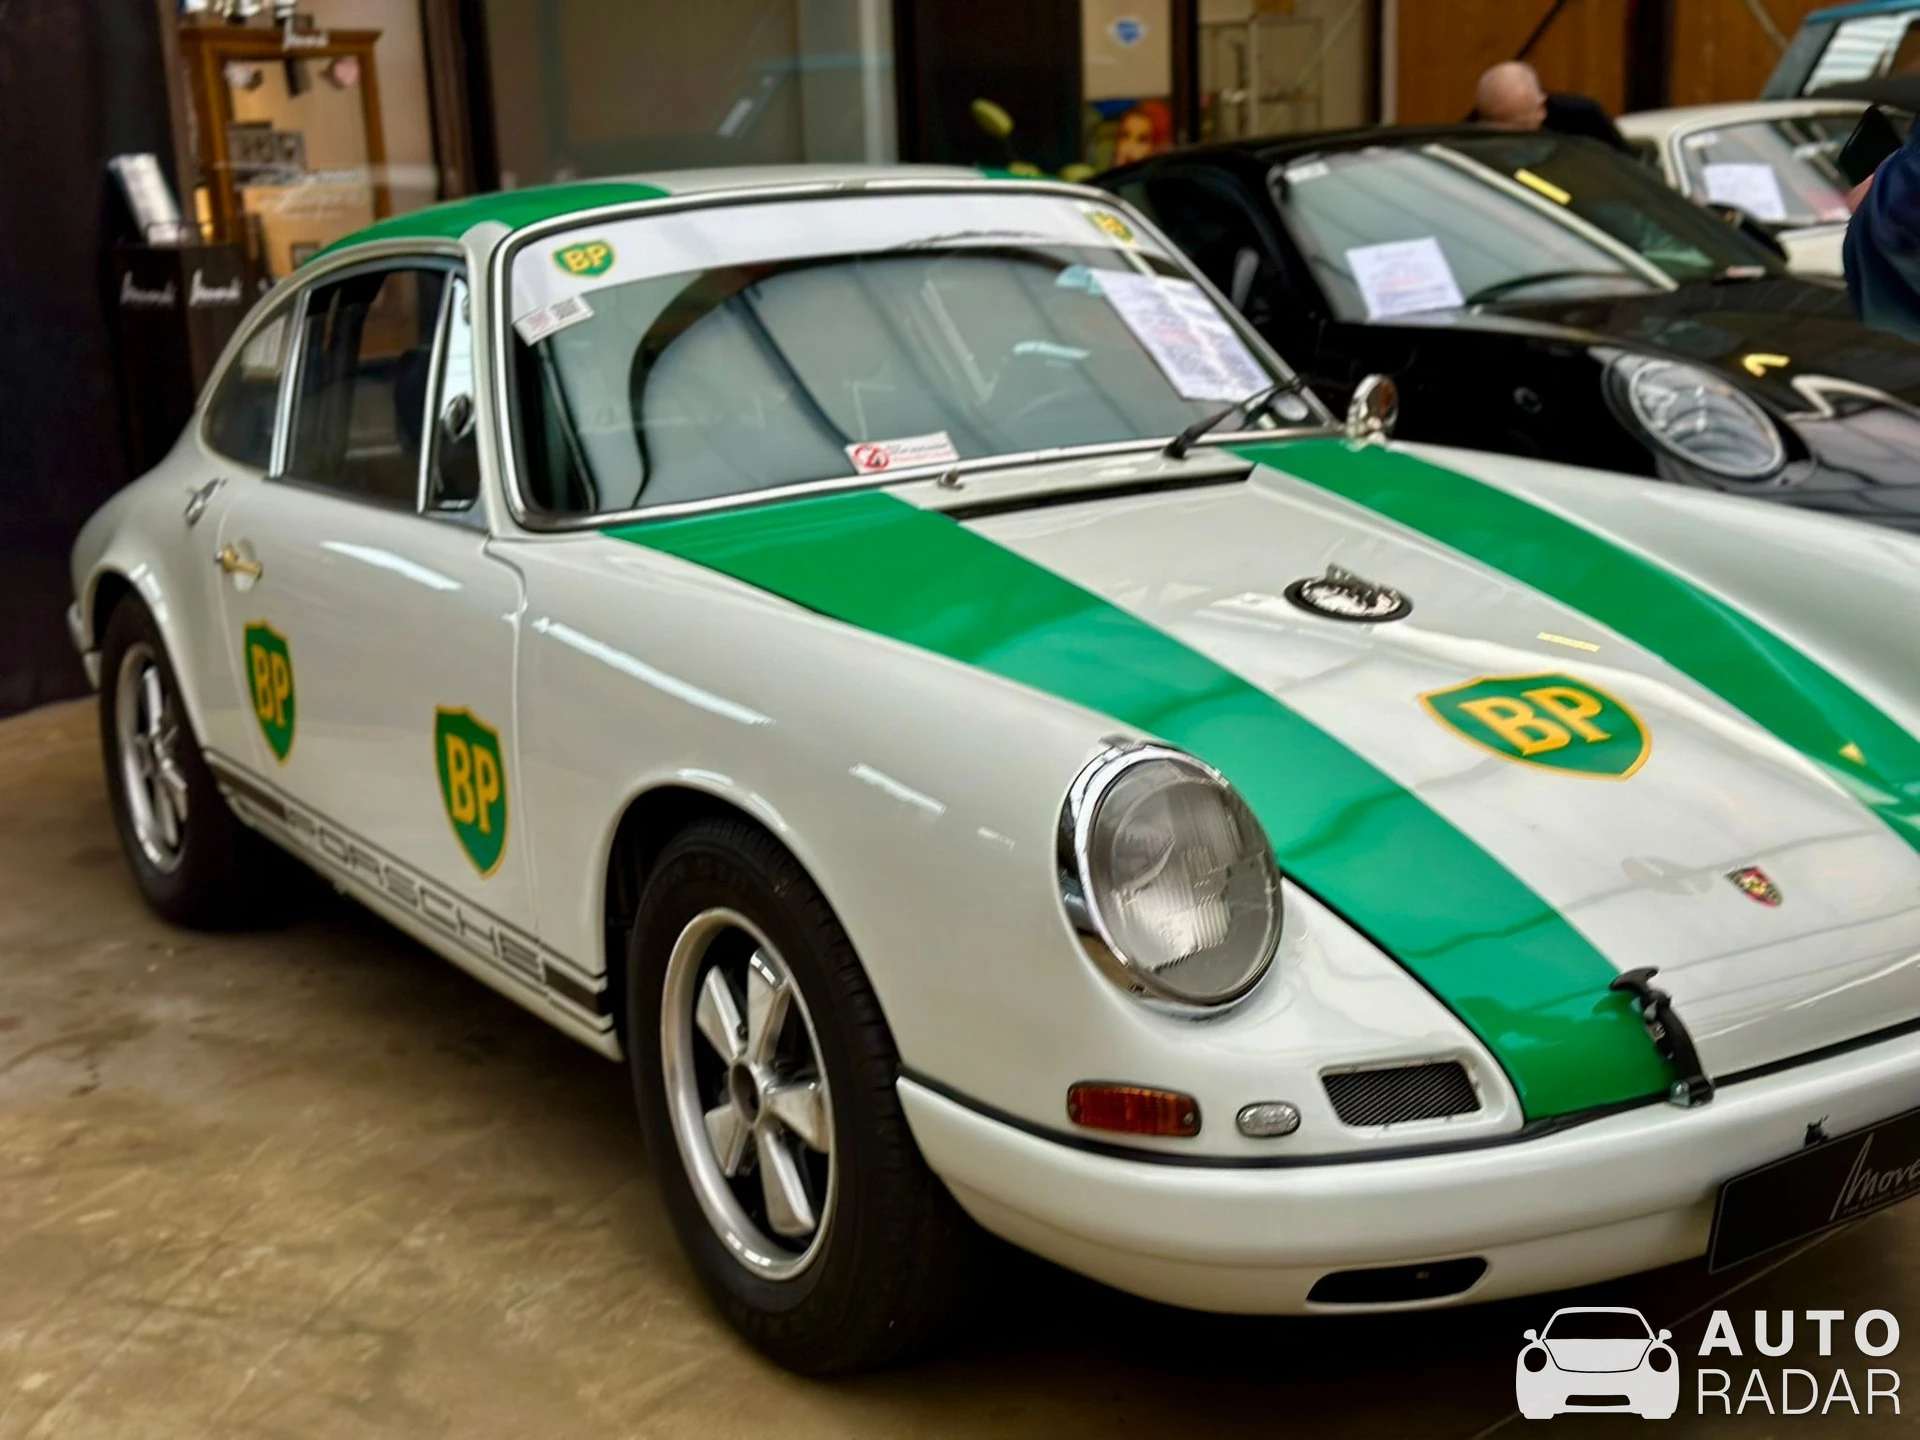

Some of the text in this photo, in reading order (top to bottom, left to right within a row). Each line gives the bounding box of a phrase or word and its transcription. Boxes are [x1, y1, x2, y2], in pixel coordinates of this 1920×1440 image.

[564, 244, 608, 273] BP
[252, 643, 290, 728] BP
[1456, 686, 1612, 756] BP
[445, 732, 500, 836] BP
[285, 807, 544, 985] PORSCHE
